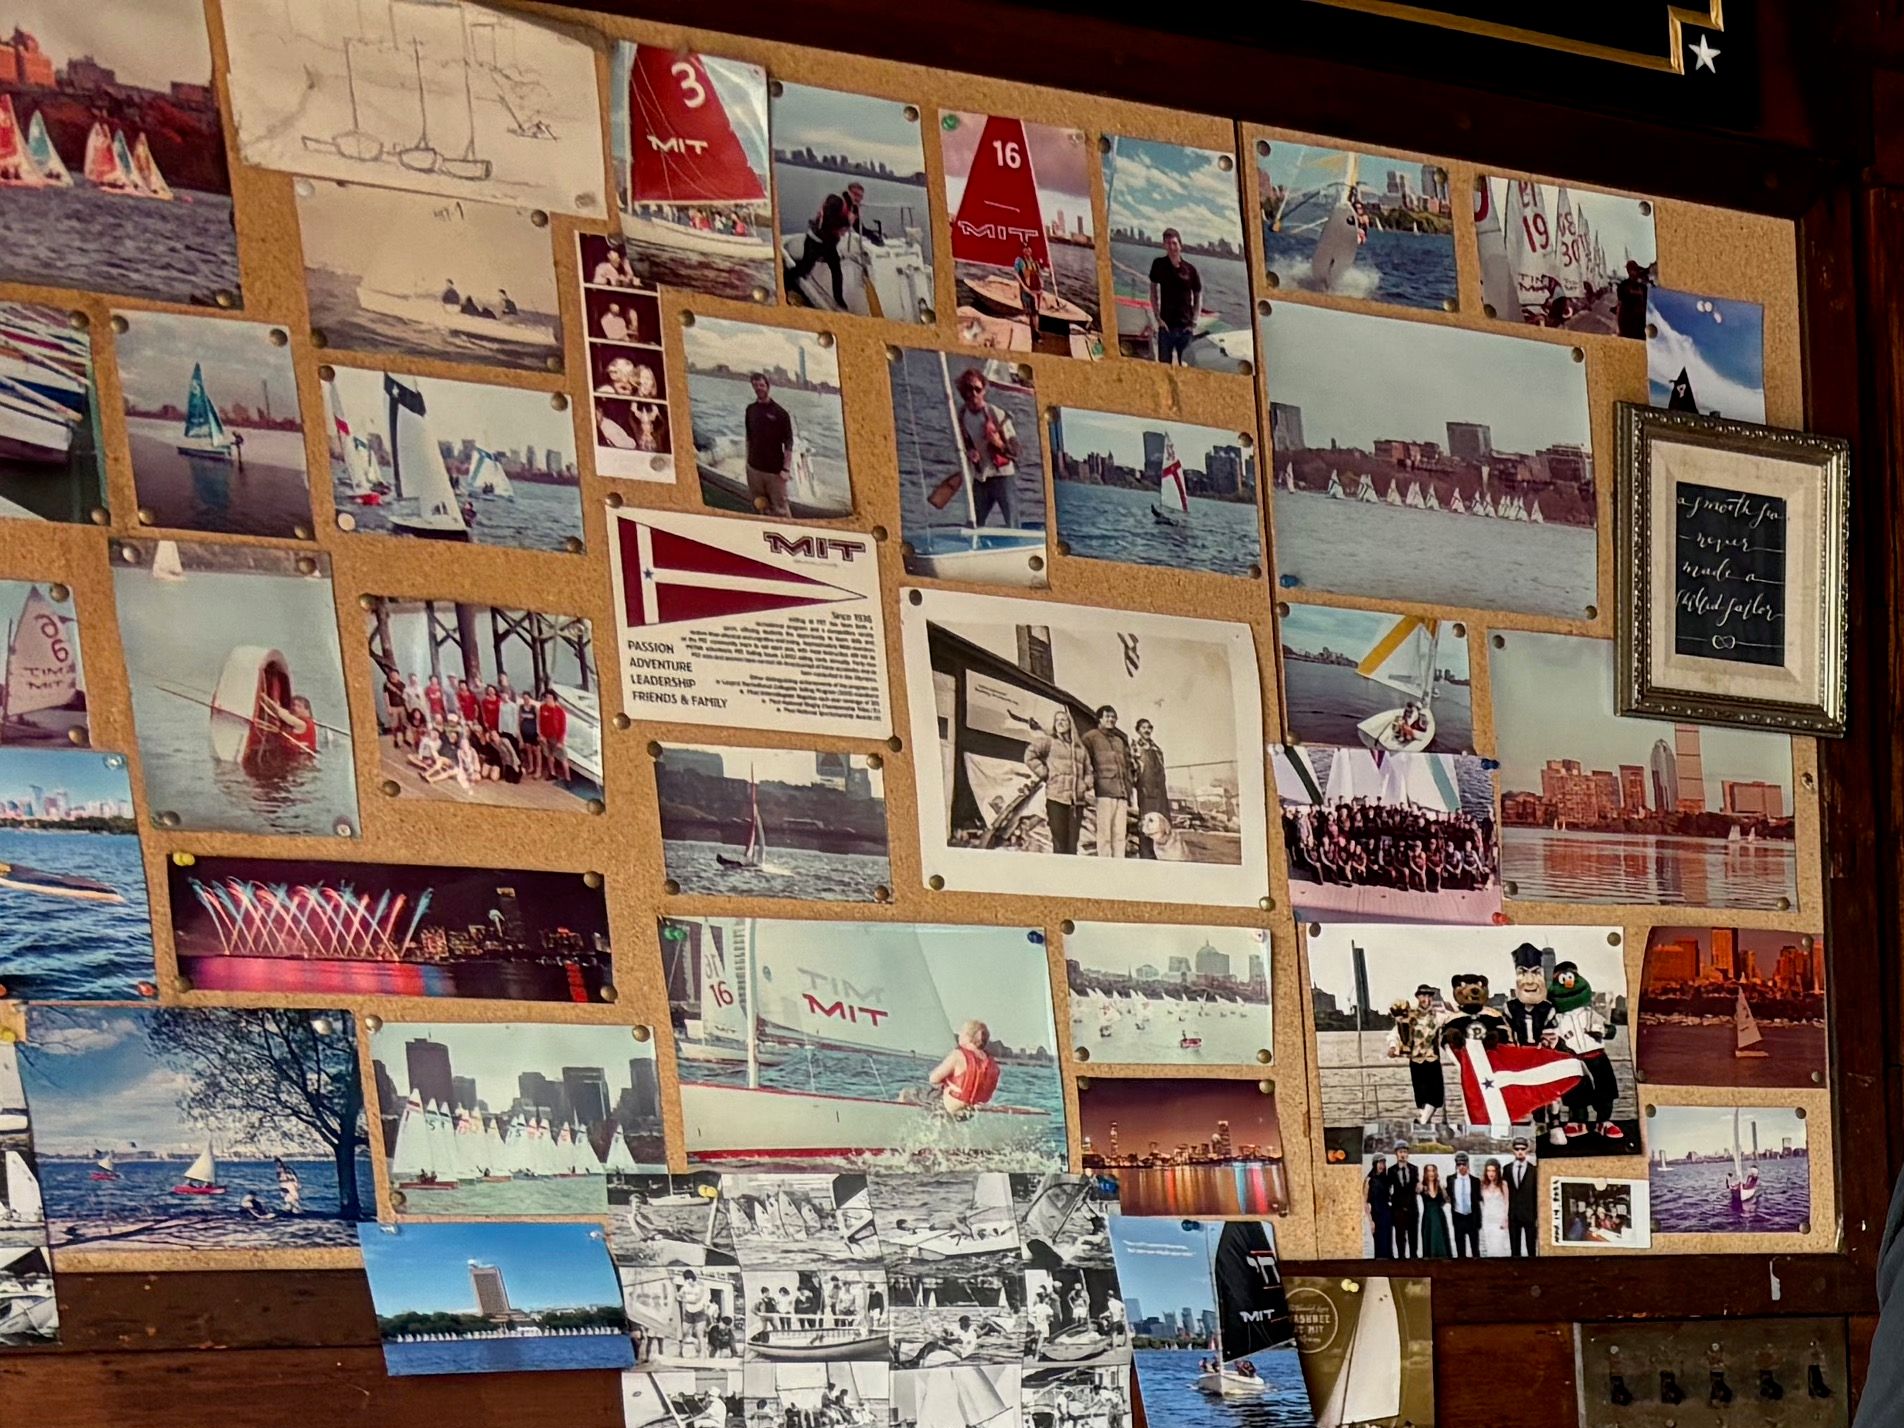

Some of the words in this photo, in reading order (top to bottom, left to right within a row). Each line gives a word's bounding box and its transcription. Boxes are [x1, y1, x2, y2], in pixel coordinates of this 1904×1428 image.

[671, 62, 706, 108] 3
[646, 134, 709, 155] MIT
[992, 140, 1022, 169] 16
[957, 220, 1039, 246] MIT
[1522, 213, 1550, 253] 19
[762, 531, 867, 562] MIT
[51, 638, 69, 663] 6
[627, 640, 675, 655] PASSION
[629, 657, 693, 673] ADVENTURE
[630, 674, 697, 689] LEADERSHIP
[632, 690, 678, 705] FRIENDS
[680, 695, 689, 706] &
[690, 695, 729, 709] FAMILY
[708, 979, 735, 1008] 16
[802, 993, 889, 1027] MIT
[1239, 1308, 1276, 1323] MIT
